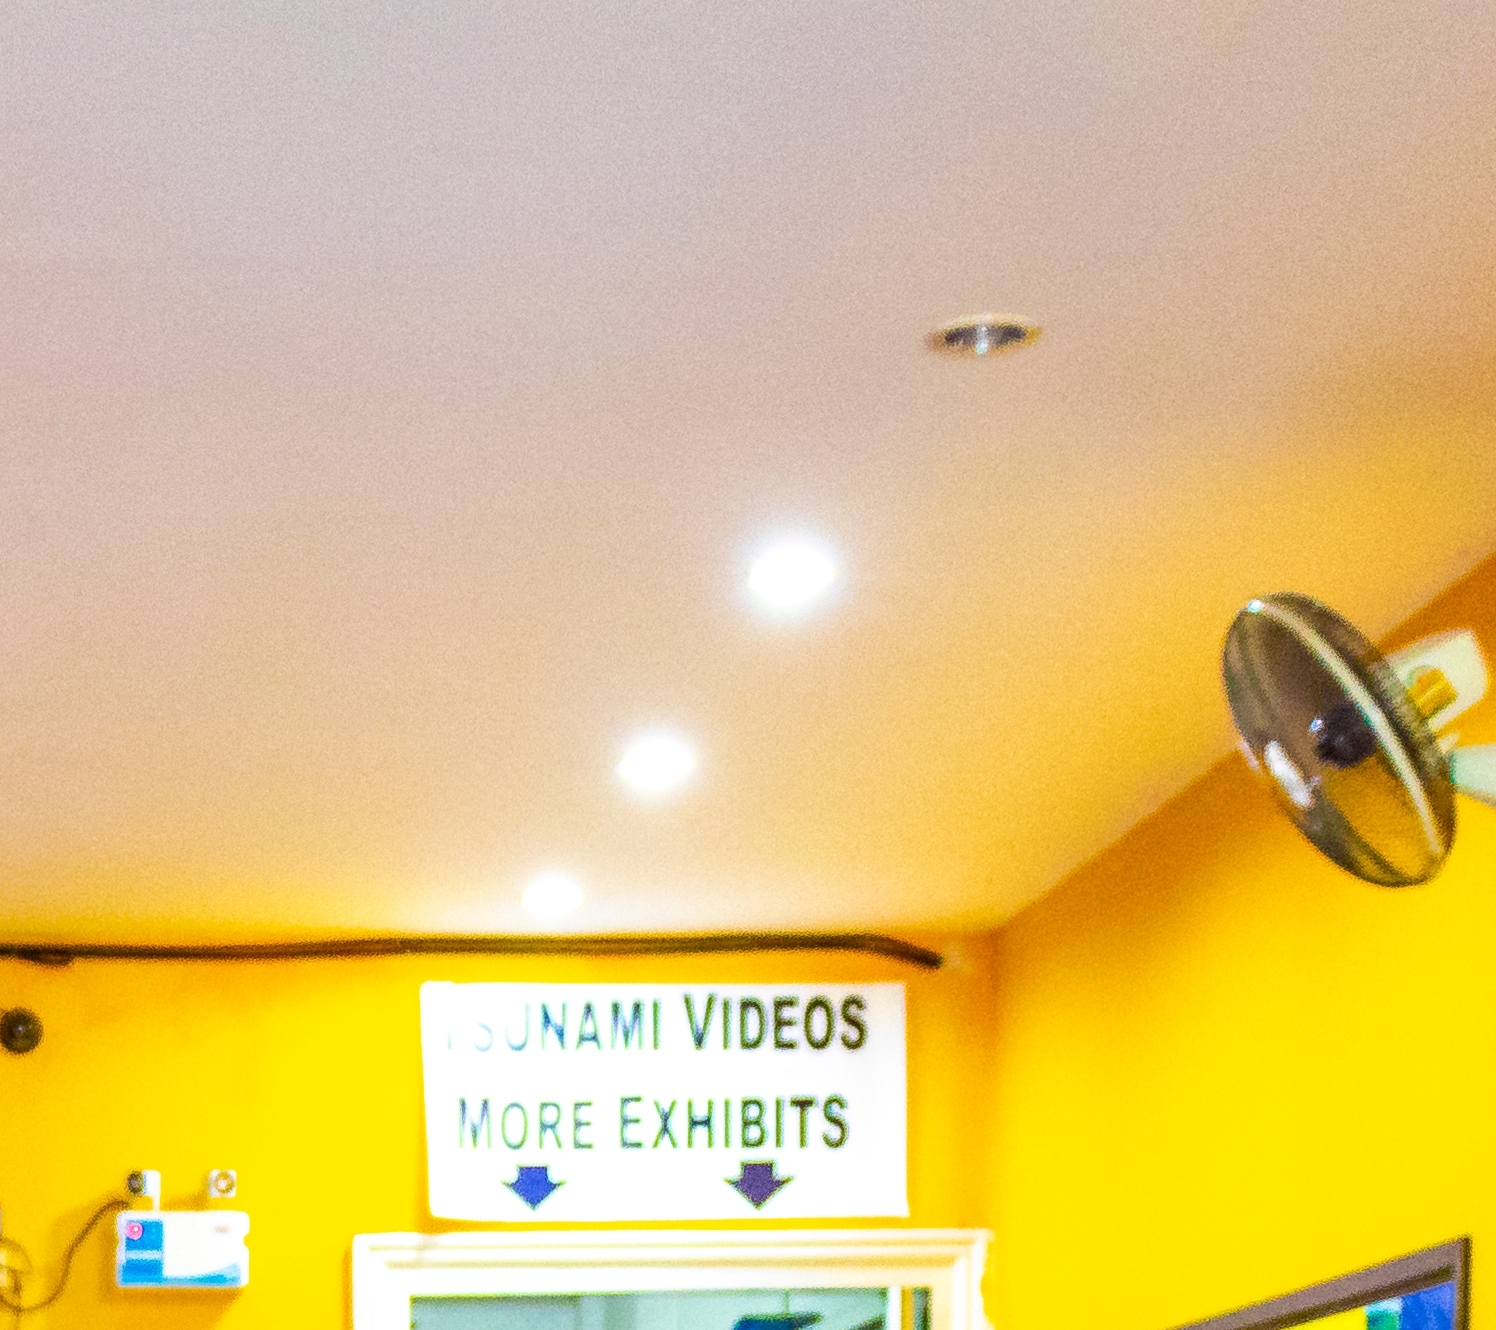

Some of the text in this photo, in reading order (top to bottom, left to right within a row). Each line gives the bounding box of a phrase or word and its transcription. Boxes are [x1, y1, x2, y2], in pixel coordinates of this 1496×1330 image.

[446, 993, 867, 1052] SUNAMI VIDEOS
[457, 1095, 850, 1150] MORE EXHIBITS
